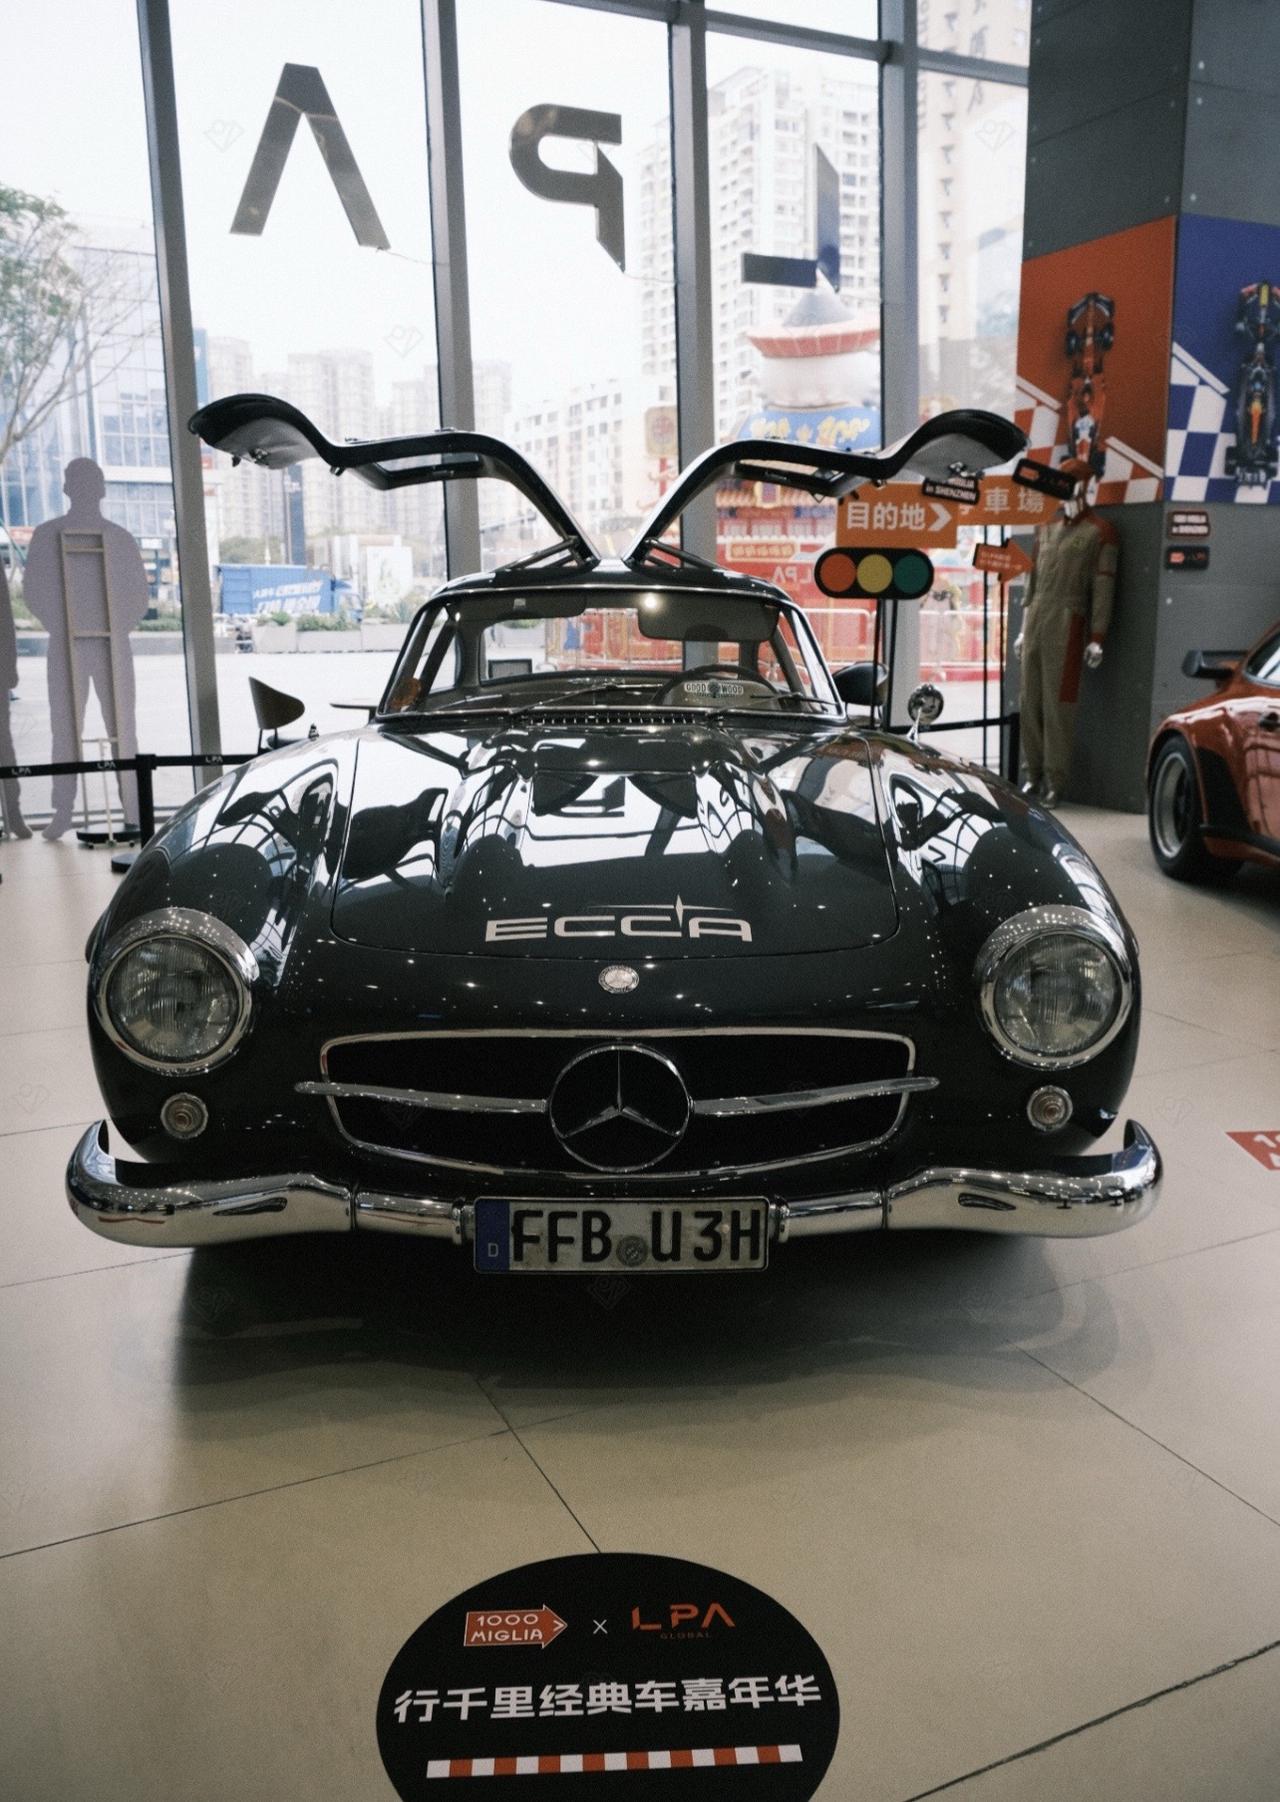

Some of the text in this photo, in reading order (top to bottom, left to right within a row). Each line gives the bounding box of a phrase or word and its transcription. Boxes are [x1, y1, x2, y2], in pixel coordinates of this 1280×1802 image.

[935, 485, 977, 501] SHENZHEN
[846, 502, 926, 531] 目的地
[487, 1242, 499, 1257] D
[511, 1209, 612, 1263] FFB
[476, 1613, 539, 1627] 1000
[631, 1602, 736, 1630] LPA
[470, 1629, 544, 1643] MIGLIA
[660, 1631, 712, 1640] GLOBAL
[393, 1674, 822, 1724] 行千里经典车嘉年华
